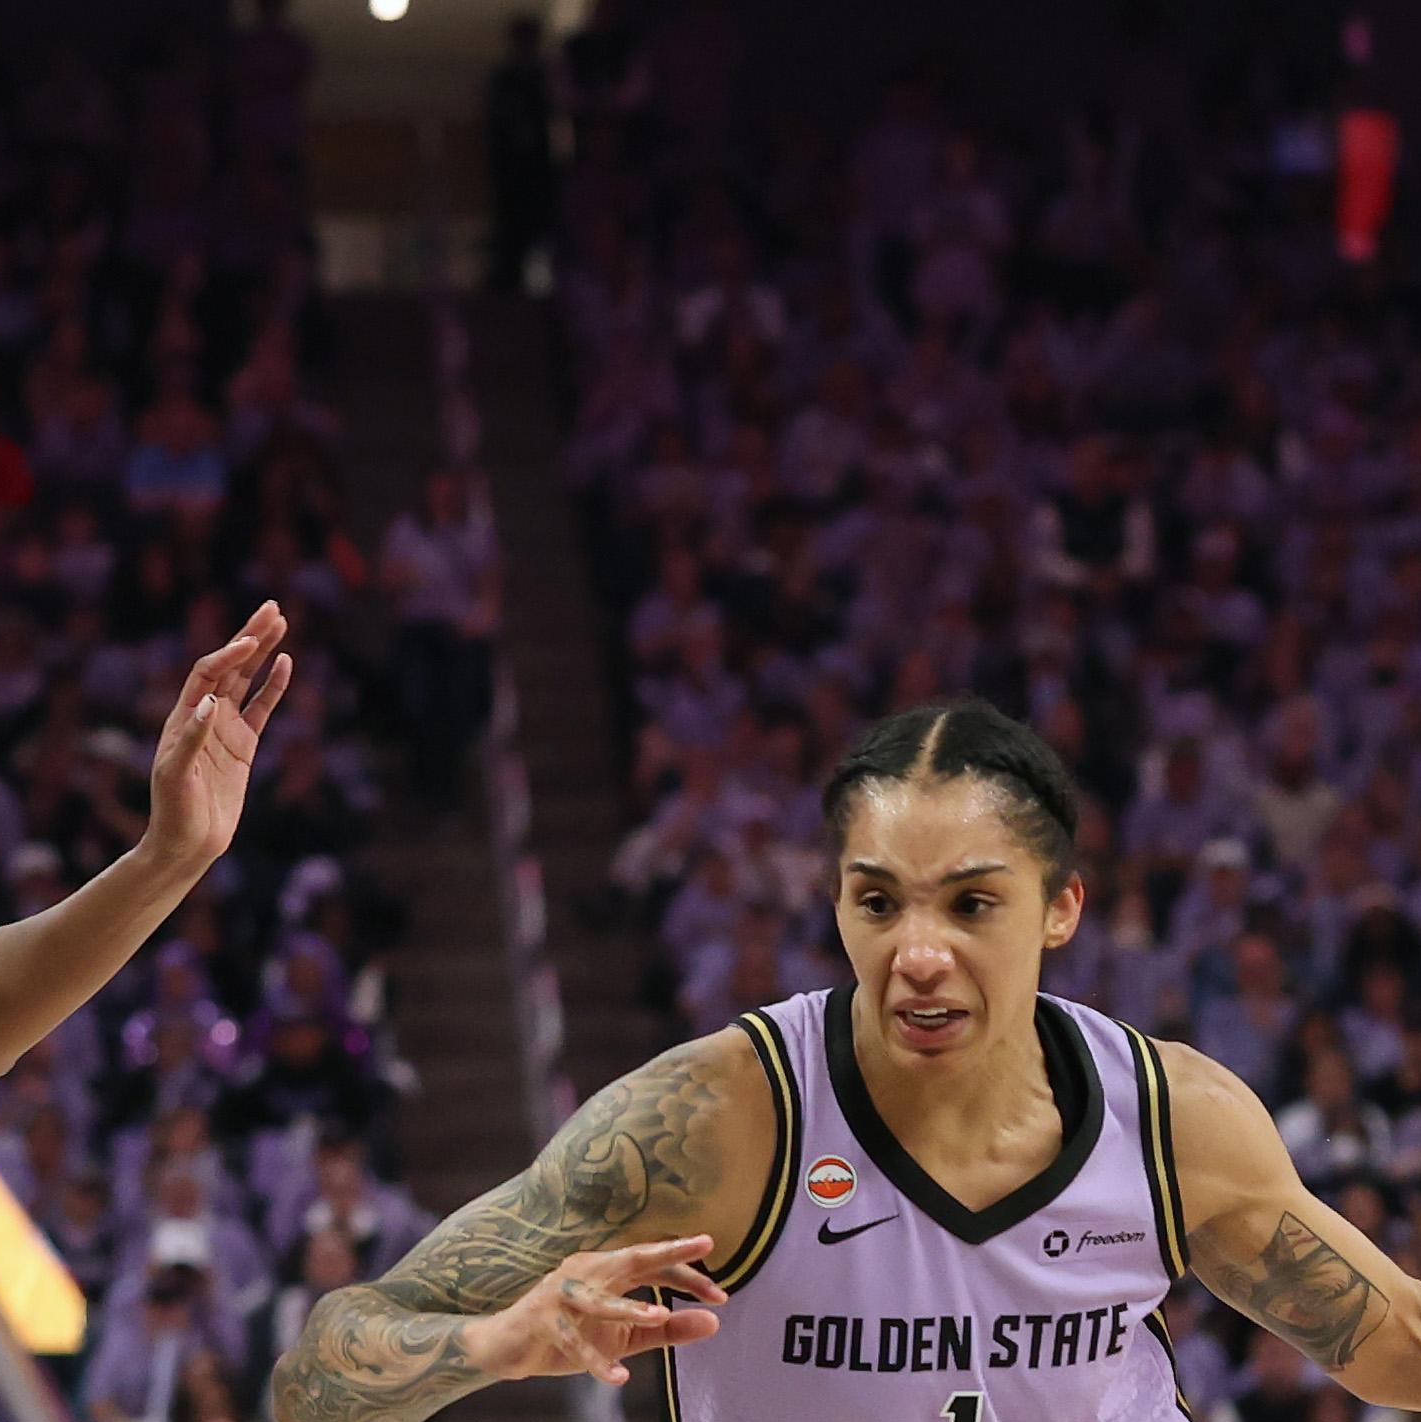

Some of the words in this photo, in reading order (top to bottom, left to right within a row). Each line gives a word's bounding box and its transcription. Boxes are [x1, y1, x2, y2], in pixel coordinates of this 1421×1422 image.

[1075, 1229, 1146, 1253] freedom
[782, 1314, 972, 1373] GOLDEN
[988, 1302, 1129, 1369] STATE
